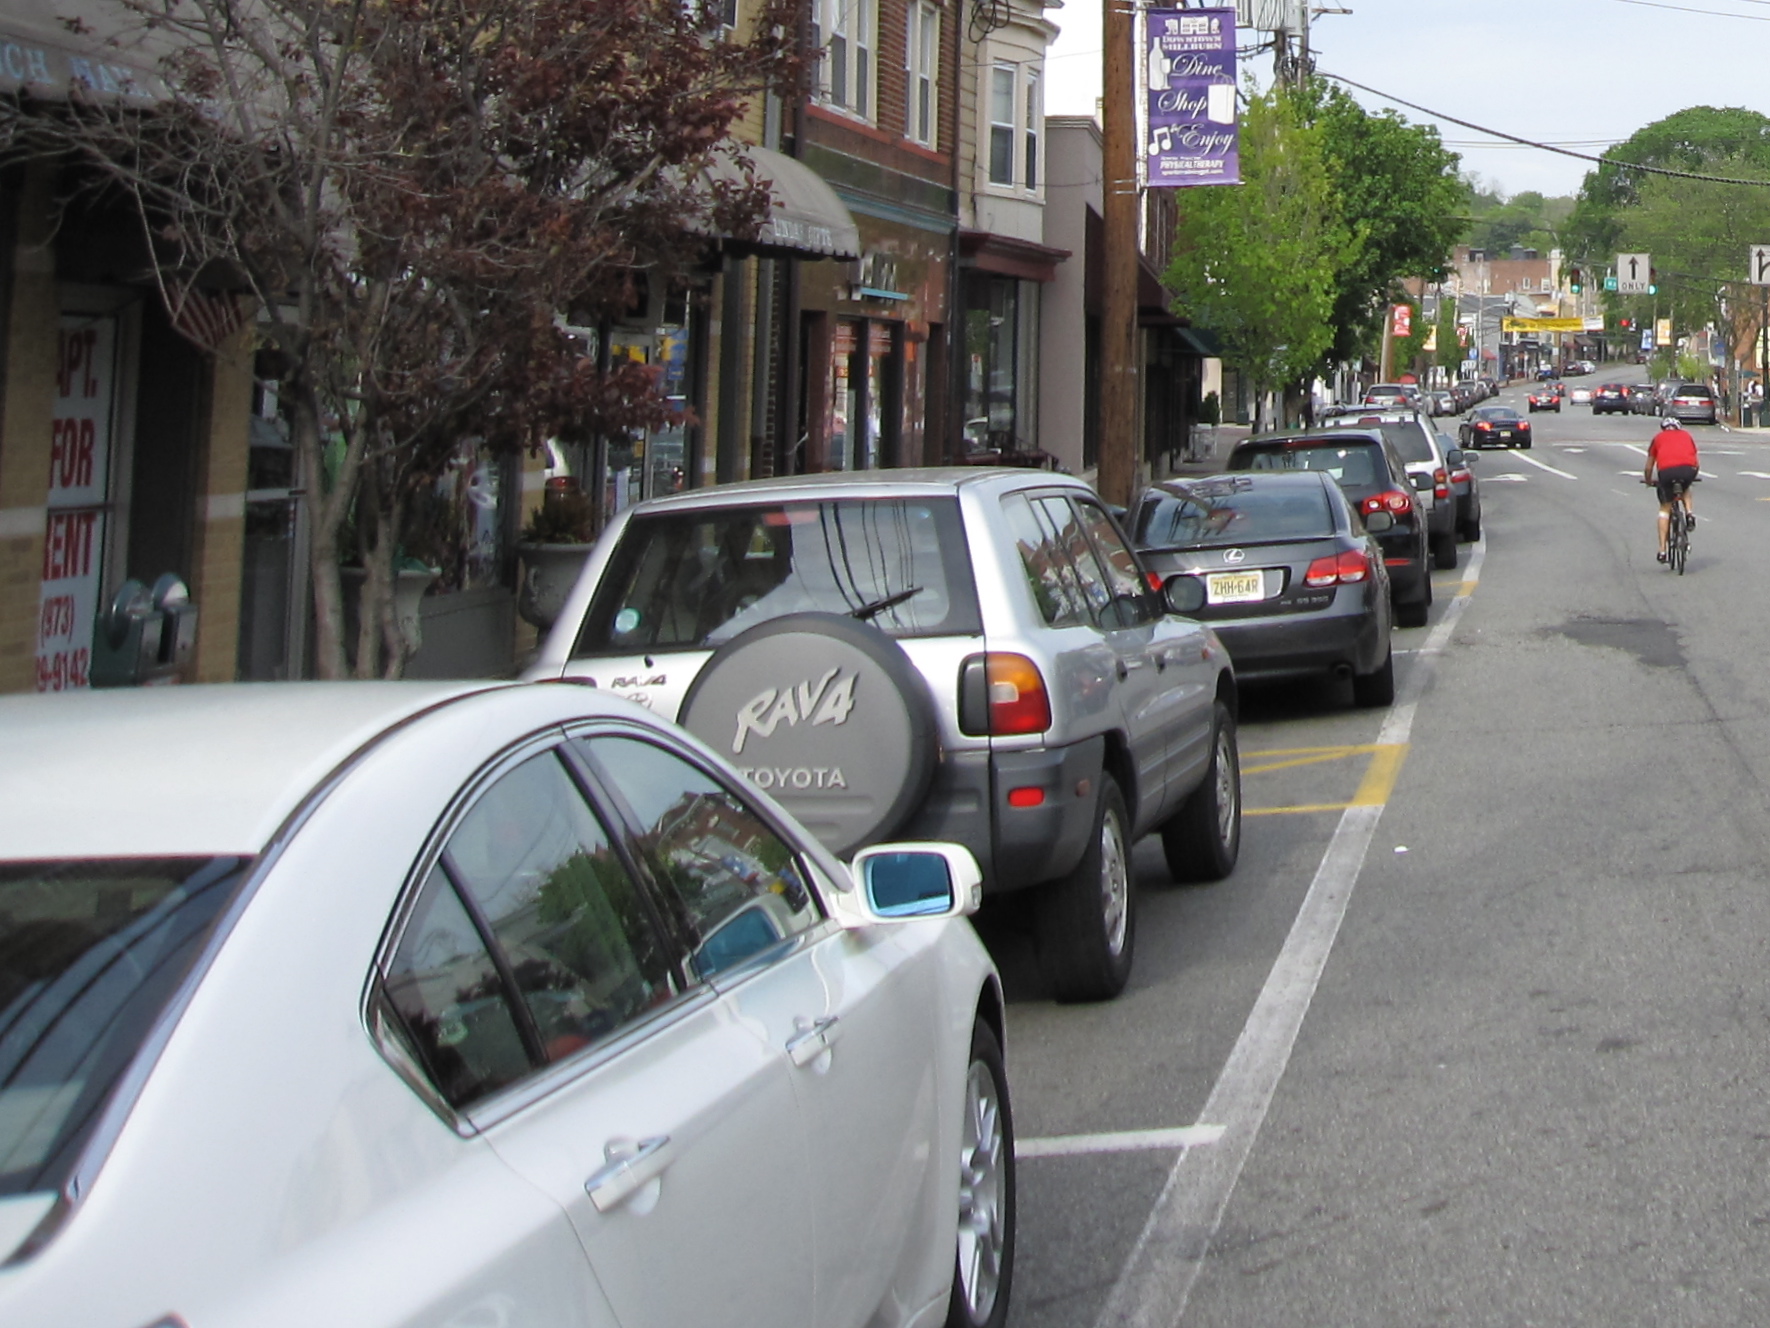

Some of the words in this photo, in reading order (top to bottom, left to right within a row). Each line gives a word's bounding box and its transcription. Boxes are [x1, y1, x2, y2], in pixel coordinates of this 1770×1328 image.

[1162, 35, 1222, 43] DOWNTOWN
[1170, 53, 1223, 77] Dine
[1158, 89, 1207, 120] Shop
[1177, 123, 1236, 156] Enjoy
[1621, 281, 1646, 290] ONLY
[50, 418, 94, 489] FOR
[42, 594, 75, 648] (973)
[611, 674, 667, 689] RAV4
[732, 665, 860, 755] RAV4
[738, 768, 848, 790] TOYOTA
